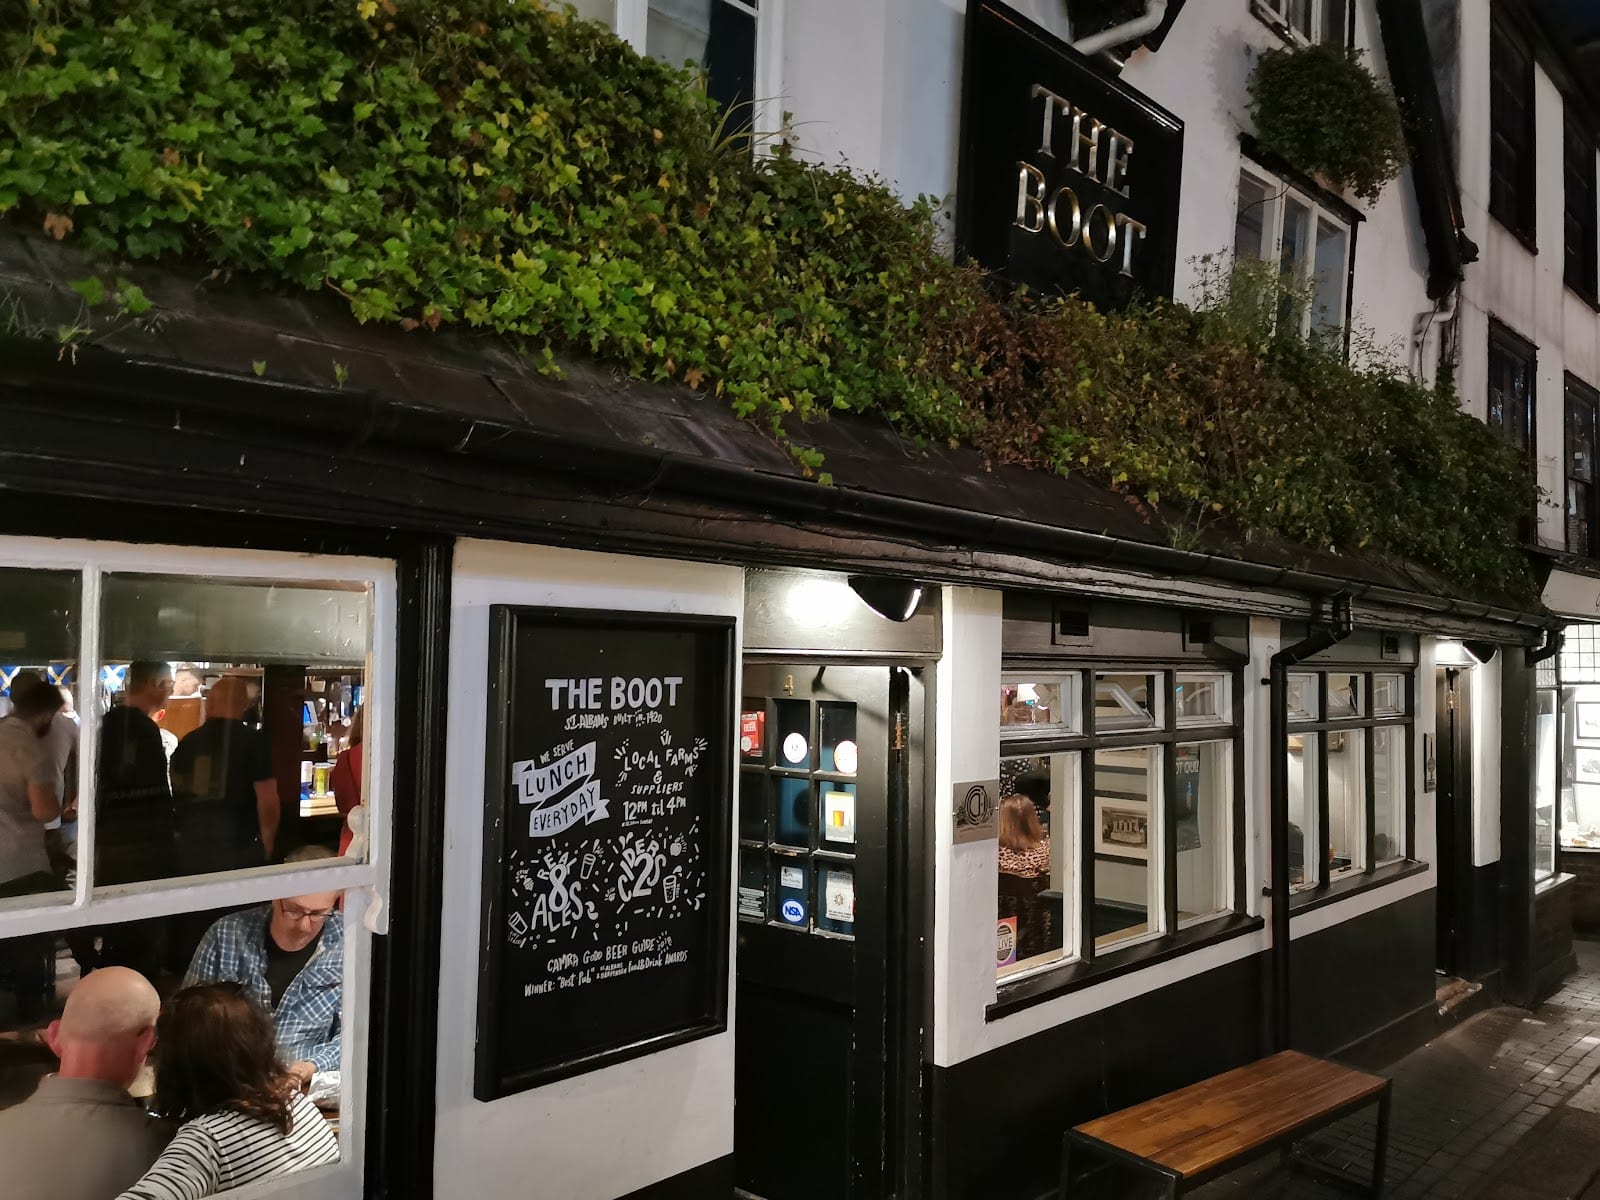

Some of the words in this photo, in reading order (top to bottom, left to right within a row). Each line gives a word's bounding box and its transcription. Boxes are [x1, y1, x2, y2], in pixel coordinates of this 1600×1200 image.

[1031, 83, 1134, 199] THE
[1012, 160, 1147, 279] BOOT
[545, 678, 602, 710] THE
[610, 676, 683, 710] BOOT
[613, 713, 632, 726] BUILT
[540, 751, 551, 764] WE
[552, 739, 574, 757] SERVE
[624, 750, 661, 771] LOCAL
[666, 747, 699, 766] FARMS
[526, 752, 587, 797] LUNCH
[631, 781, 684, 795] SUPPLIERS
[653, 770, 663, 784] &
[533, 787, 595, 831] EVERYDAY
[651, 799, 665, 816] til
[537, 852, 578, 880] REAL
[618, 838, 667, 902] CIDERS
[633, 853, 654, 897] 2
[548, 863, 569, 912] 8
[531, 881, 584, 932] ALES
[547, 953, 579, 973] CAMRA
[606, 944, 628, 961] BEER
[632, 938, 656, 954] GUIDE
[665, 950, 688, 965] AWARDS
[525, 980, 555, 997] WINNER:
